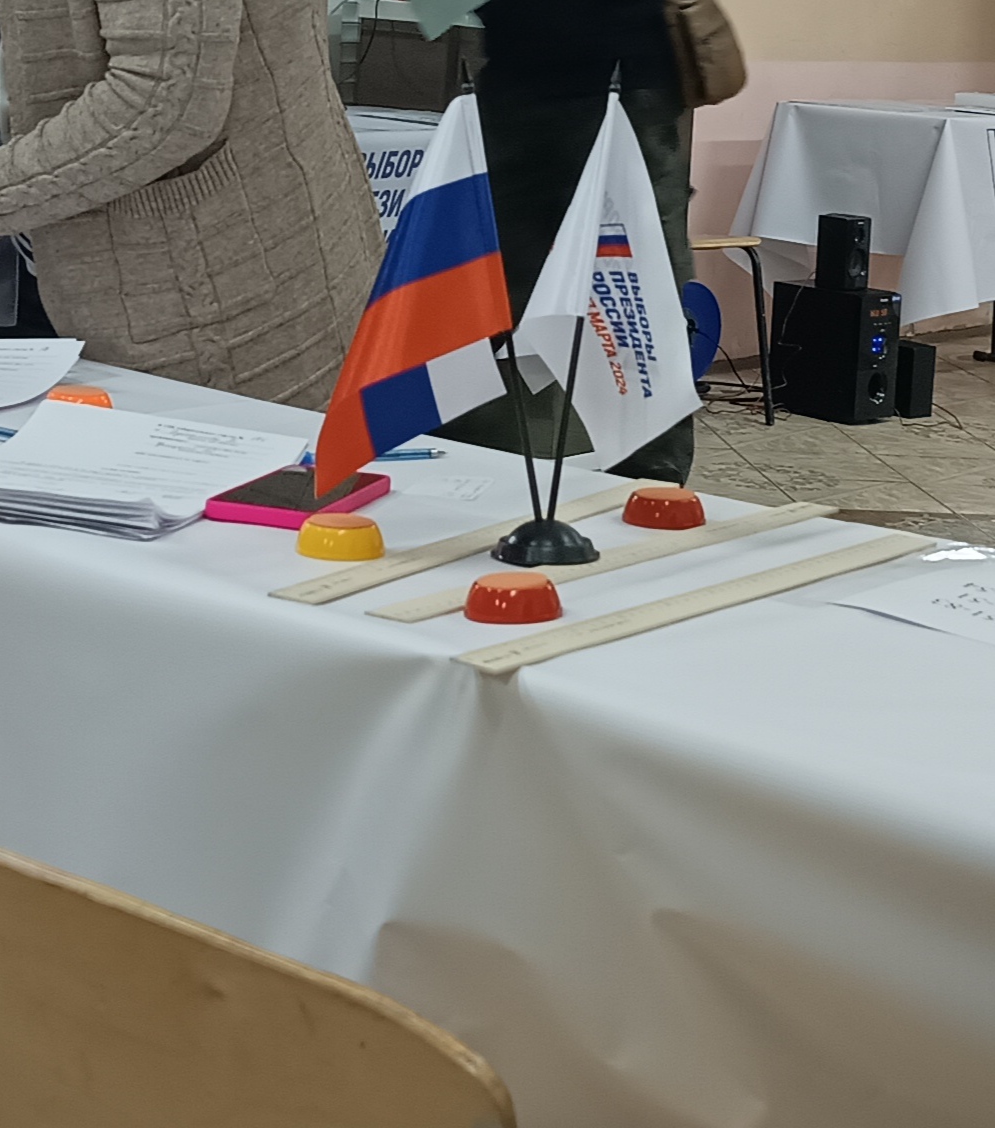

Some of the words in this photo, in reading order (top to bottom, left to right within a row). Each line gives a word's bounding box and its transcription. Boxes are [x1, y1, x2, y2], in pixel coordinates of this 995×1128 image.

[361, 149, 424, 179] ЫБОР
[587, 310, 618, 358] МАРТА
[609, 360, 629, 396] 2024
[609, 270, 653, 399] ПРЕЗИДЕНТА
[627, 271, 657, 362] ВЫБОРЫ
